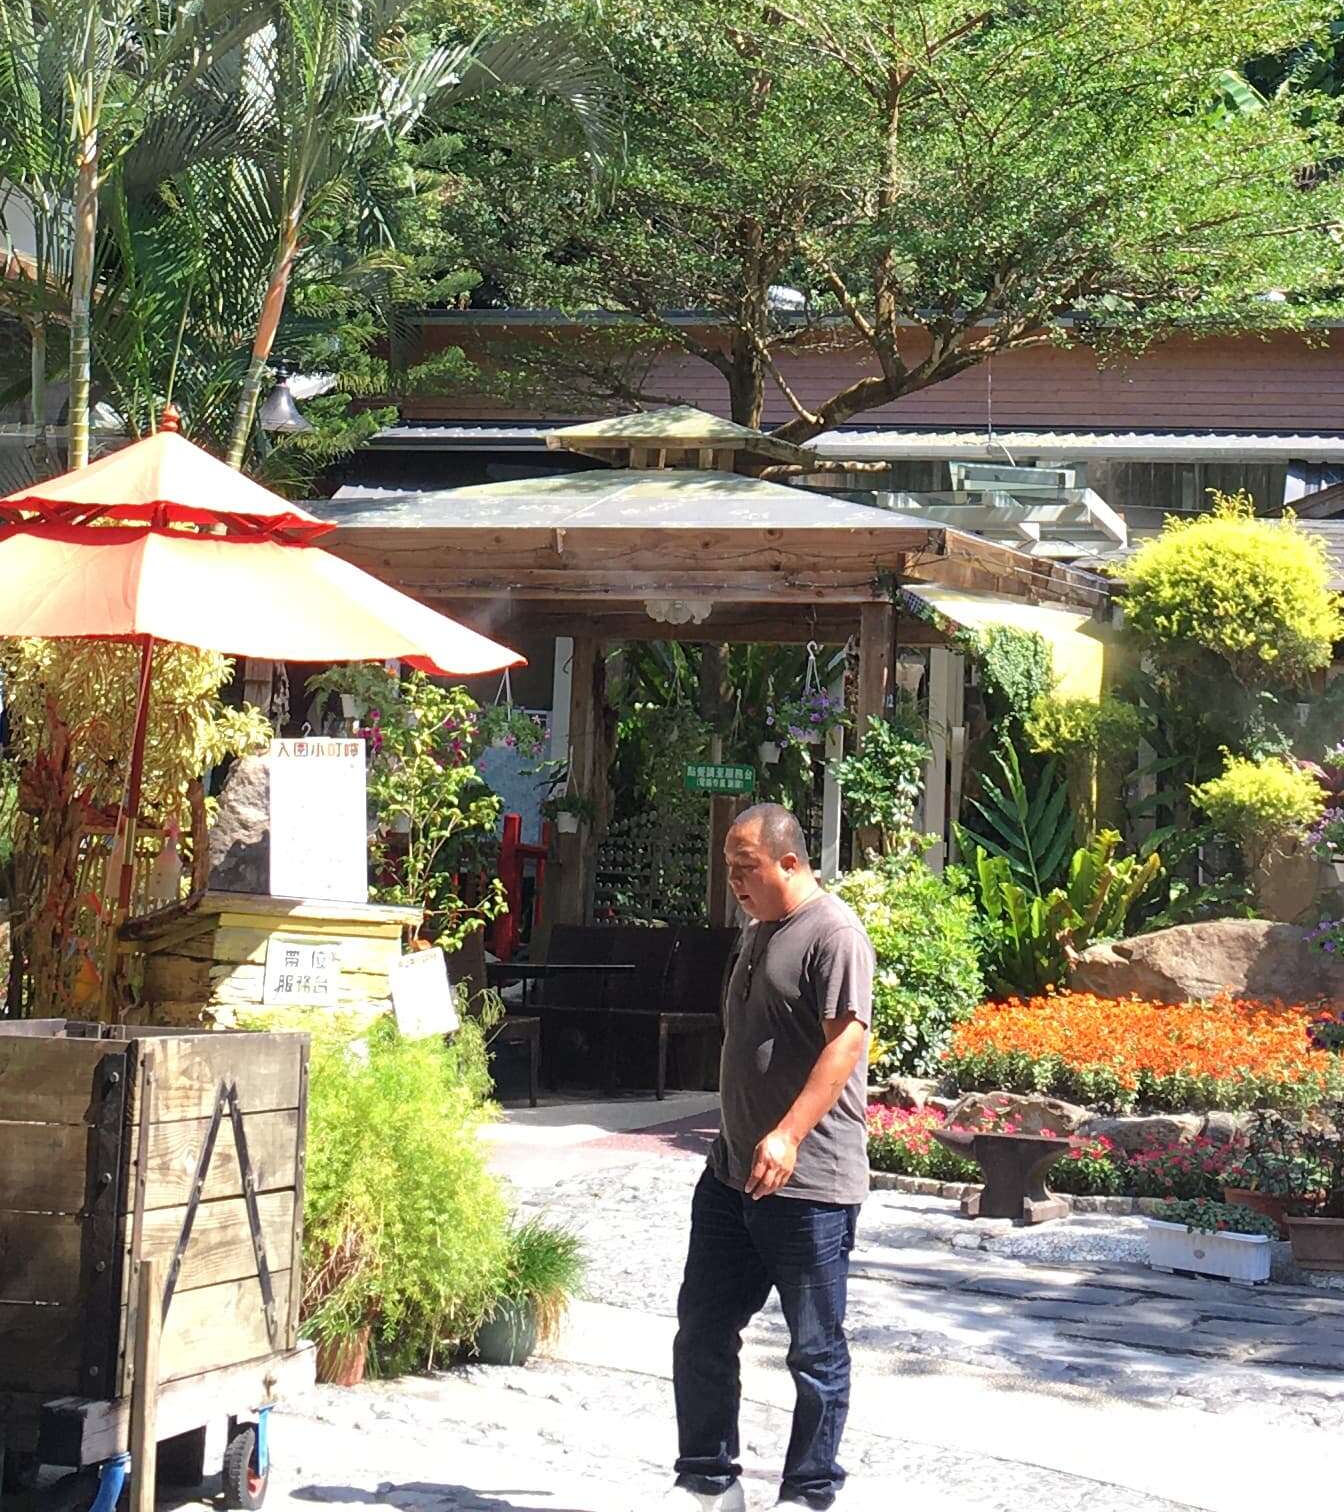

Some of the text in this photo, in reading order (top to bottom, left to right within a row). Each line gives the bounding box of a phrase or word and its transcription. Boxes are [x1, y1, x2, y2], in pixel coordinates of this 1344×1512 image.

[278, 741, 359, 758] 入園小叮嚀
